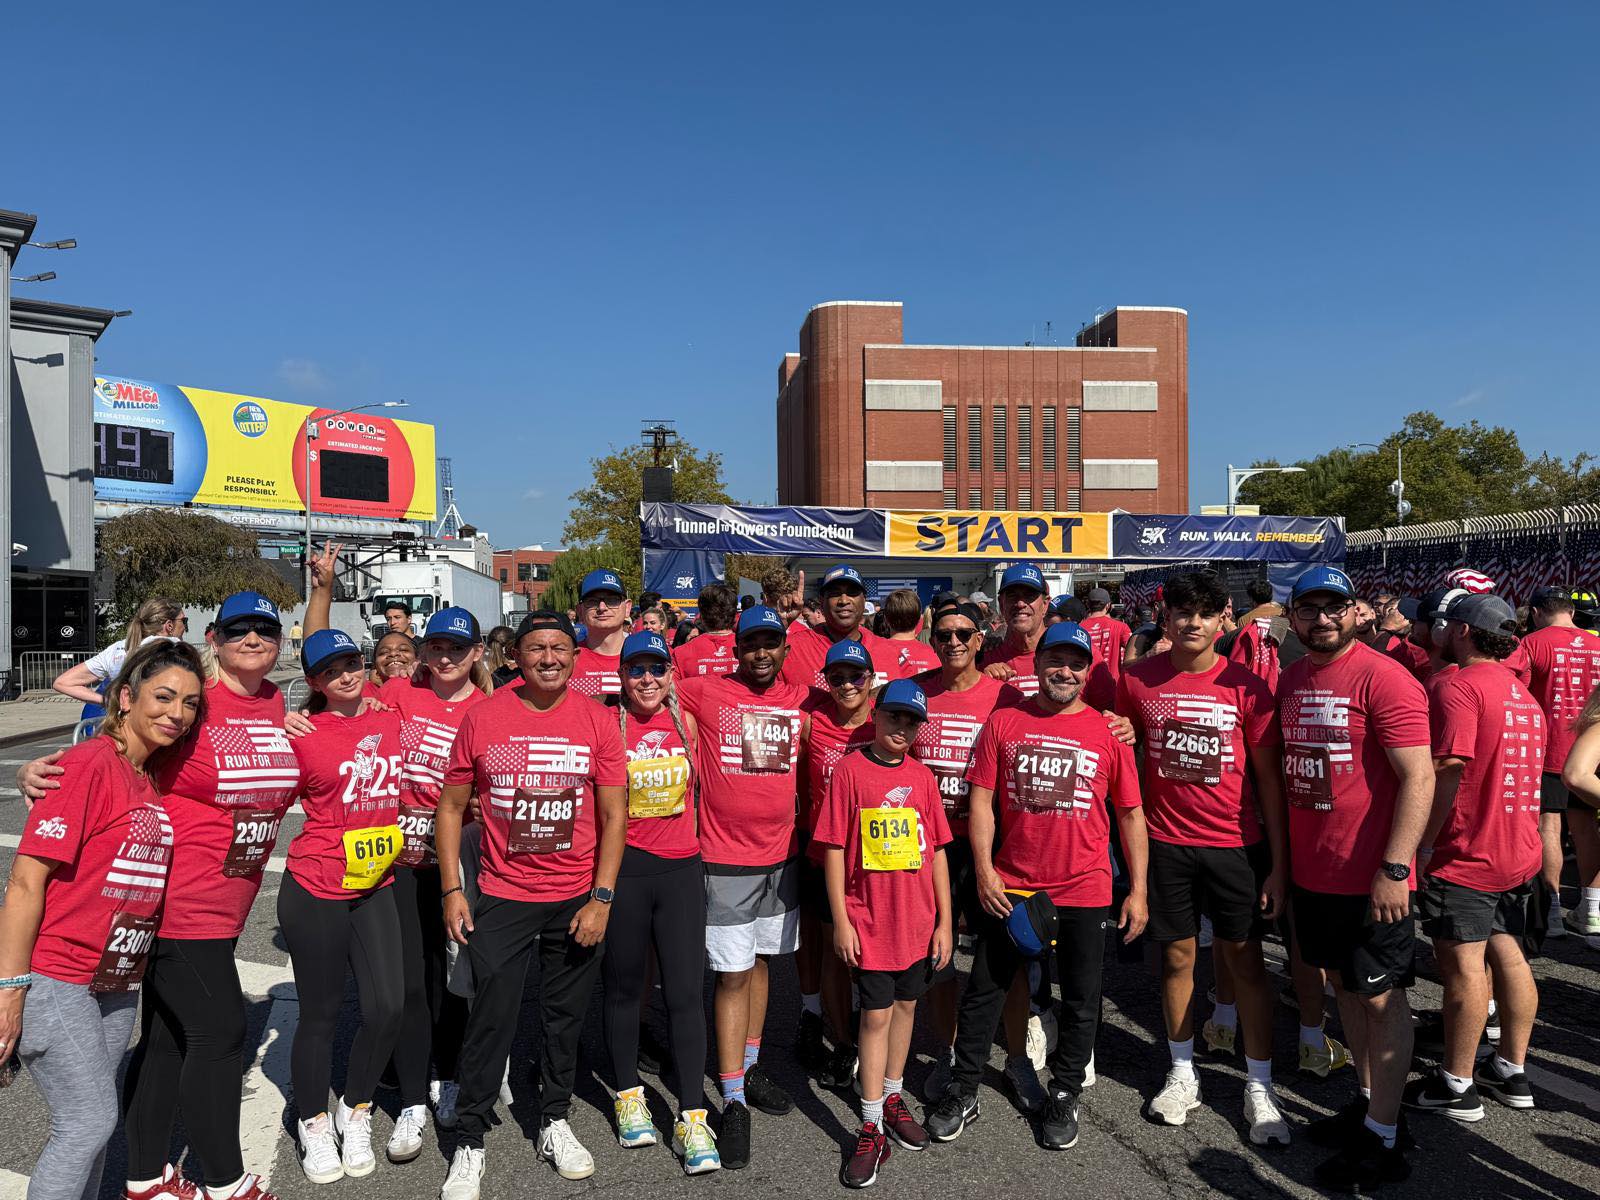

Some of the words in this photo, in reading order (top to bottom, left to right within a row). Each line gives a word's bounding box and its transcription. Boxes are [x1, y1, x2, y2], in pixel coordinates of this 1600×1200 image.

[115, 383, 159, 404] MEGA
[113, 401, 159, 409] MILLIONS
[94, 412, 132, 420] STIMATED
[309, 449, 318, 461] $
[327, 440, 359, 449] ESTIMATED
[360, 445, 383, 453] JACKPOT
[100, 465, 159, 480] MILLION
[226, 475, 256, 485] PLEASE
[256, 478, 275, 487] PLAY
[224, 485, 278, 496] RESPONSIBLY.
[673, 517, 720, 534] Tunnel
[730, 519, 778, 537] Towers
[779, 521, 854, 541] Foundation
[915, 516, 1084, 553] START
[1140, 527, 1167, 545] 5K
[1180, 531, 1210, 542] RUN.
[1213, 532, 1253, 542] WALK.
[1255, 532, 1326, 544] REMEMBER.
[675, 576, 695, 590] 5K
[448, 626, 470, 635] HONDA
[744, 722, 790, 744] 21484
[1293, 727, 1308, 740] FOR
[1309, 728, 1351, 741] HEROES
[1165, 730, 1220, 756] 22663
[225, 753, 251, 769] RUN
[251, 754, 272, 768] FOR
[408, 750, 430, 766] FOR
[933, 746, 952, 759] FOR
[1017, 754, 1073, 778] 21487
[1286, 754, 1325, 779] 21481
[338, 754, 403, 804] 225
[491, 774, 514, 787] RUN
[517, 774, 541, 787] FOR
[633, 766, 684, 790] 33917
[937, 776, 969, 796] 485
[361, 801, 376, 812] FOR
[515, 799, 573, 821] 21488
[1055, 800, 1072, 808] 21487
[1314, 802, 1332, 810] 21481
[235, 819, 280, 844] 23016
[397, 815, 436, 836] 2266
[869, 818, 910, 839] 6134
[127, 843, 153, 861] RUN
[150, 846, 165, 862] FOR
[355, 835, 393, 860] 6161
